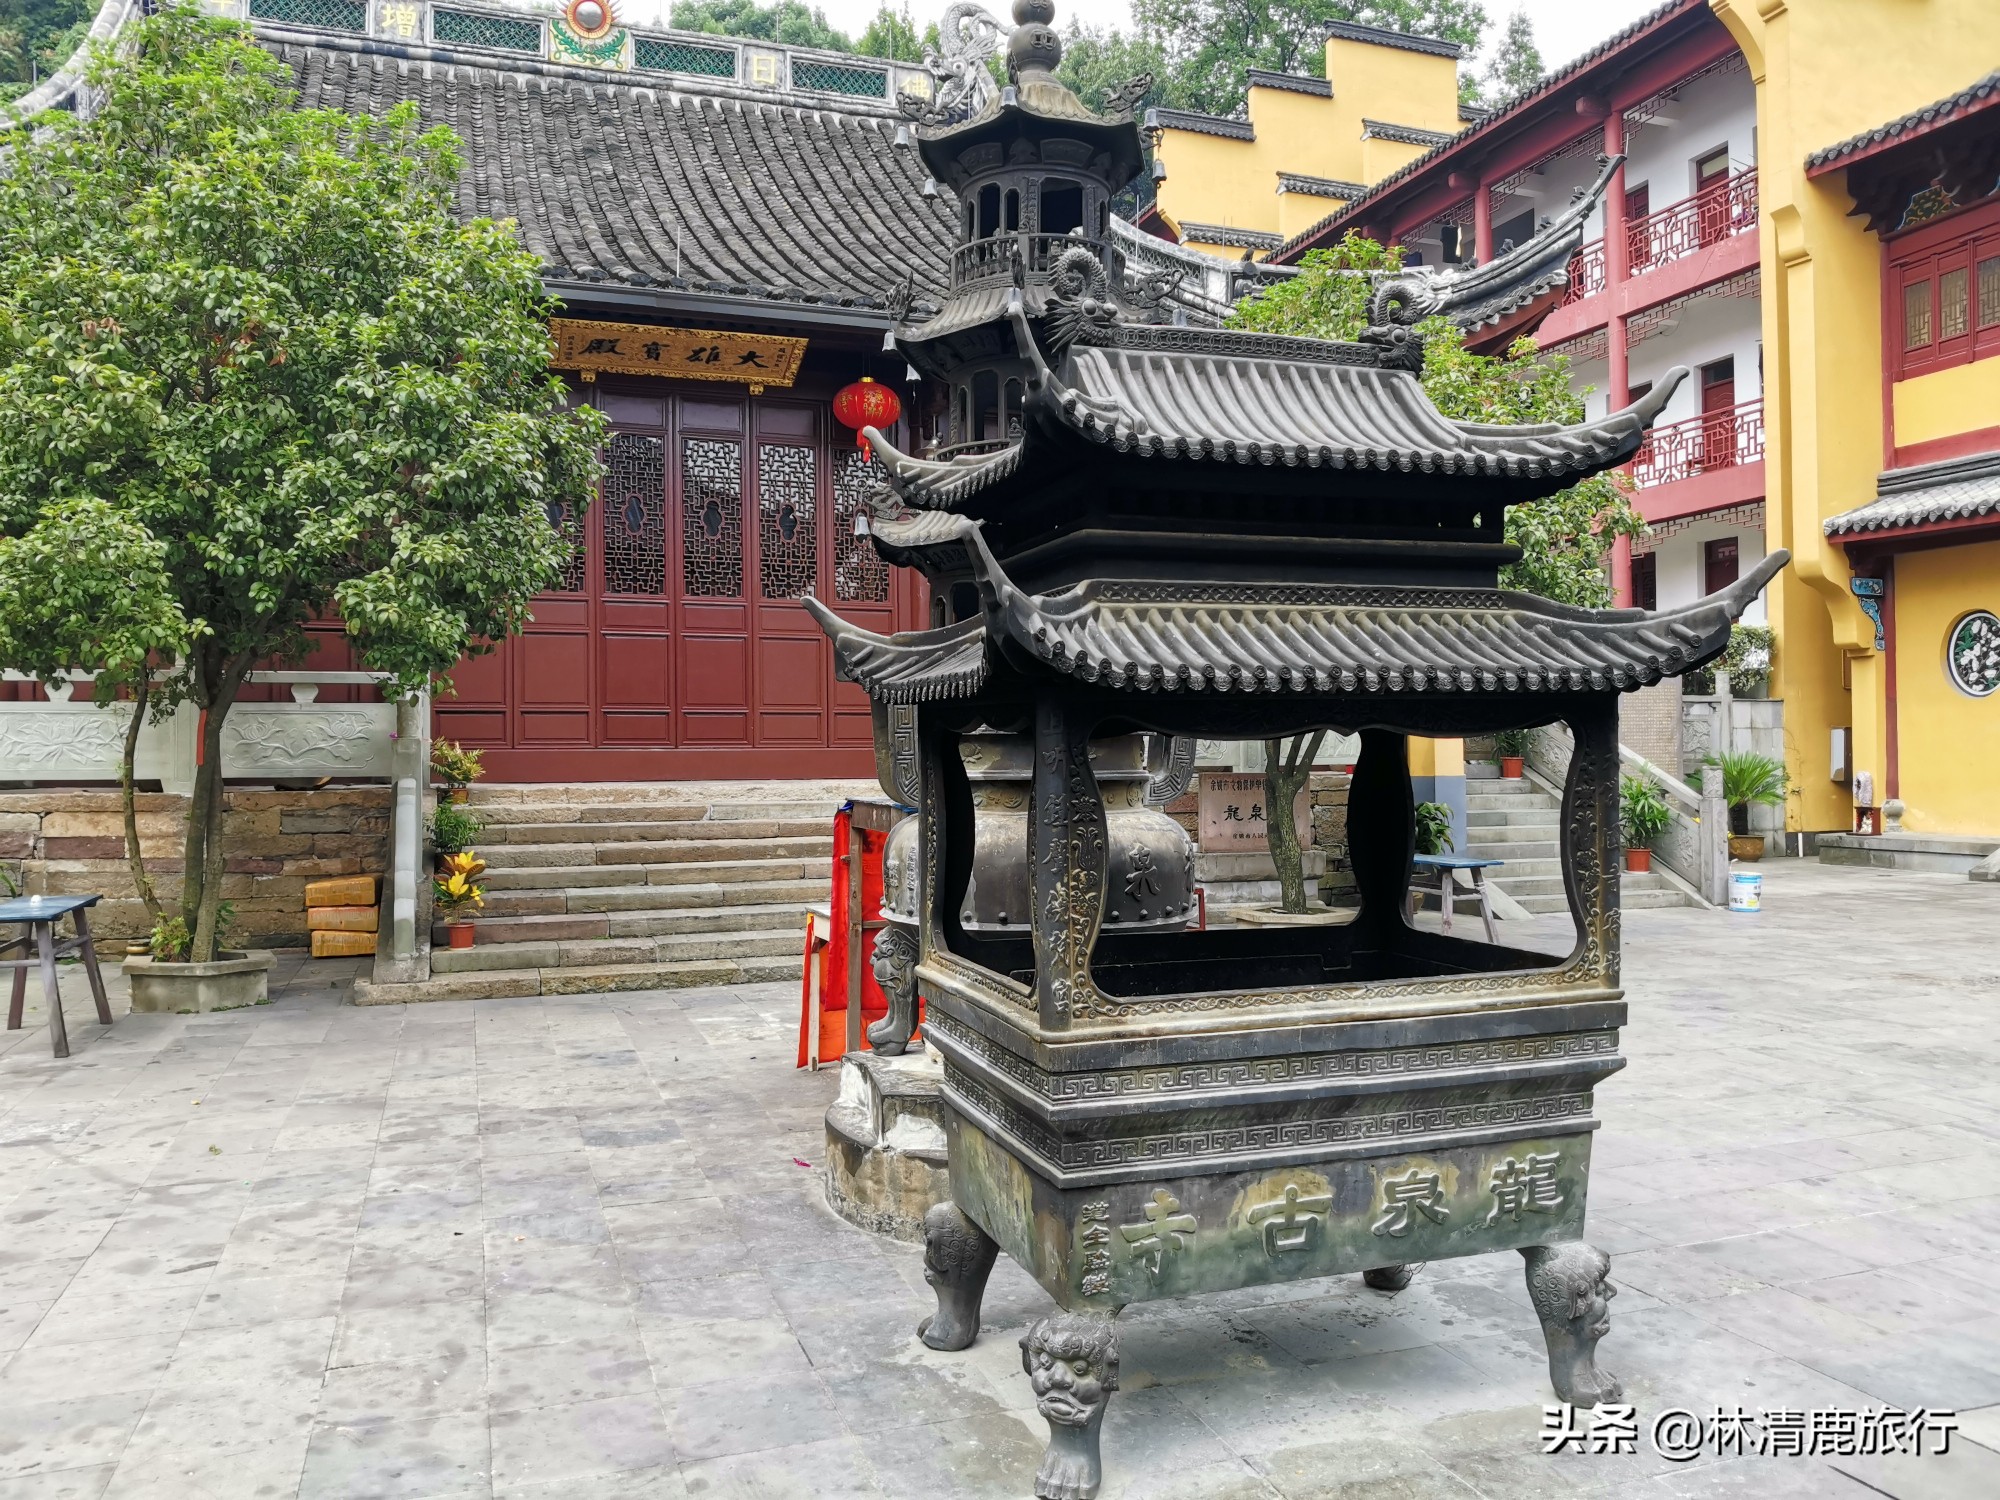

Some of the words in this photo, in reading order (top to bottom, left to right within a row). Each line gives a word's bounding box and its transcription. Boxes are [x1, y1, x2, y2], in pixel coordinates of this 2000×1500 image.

[381, 3, 417, 37] 增
[753, 54, 776, 85] 日
[1120, 1151, 1566, 1287] 龍泉古寺
